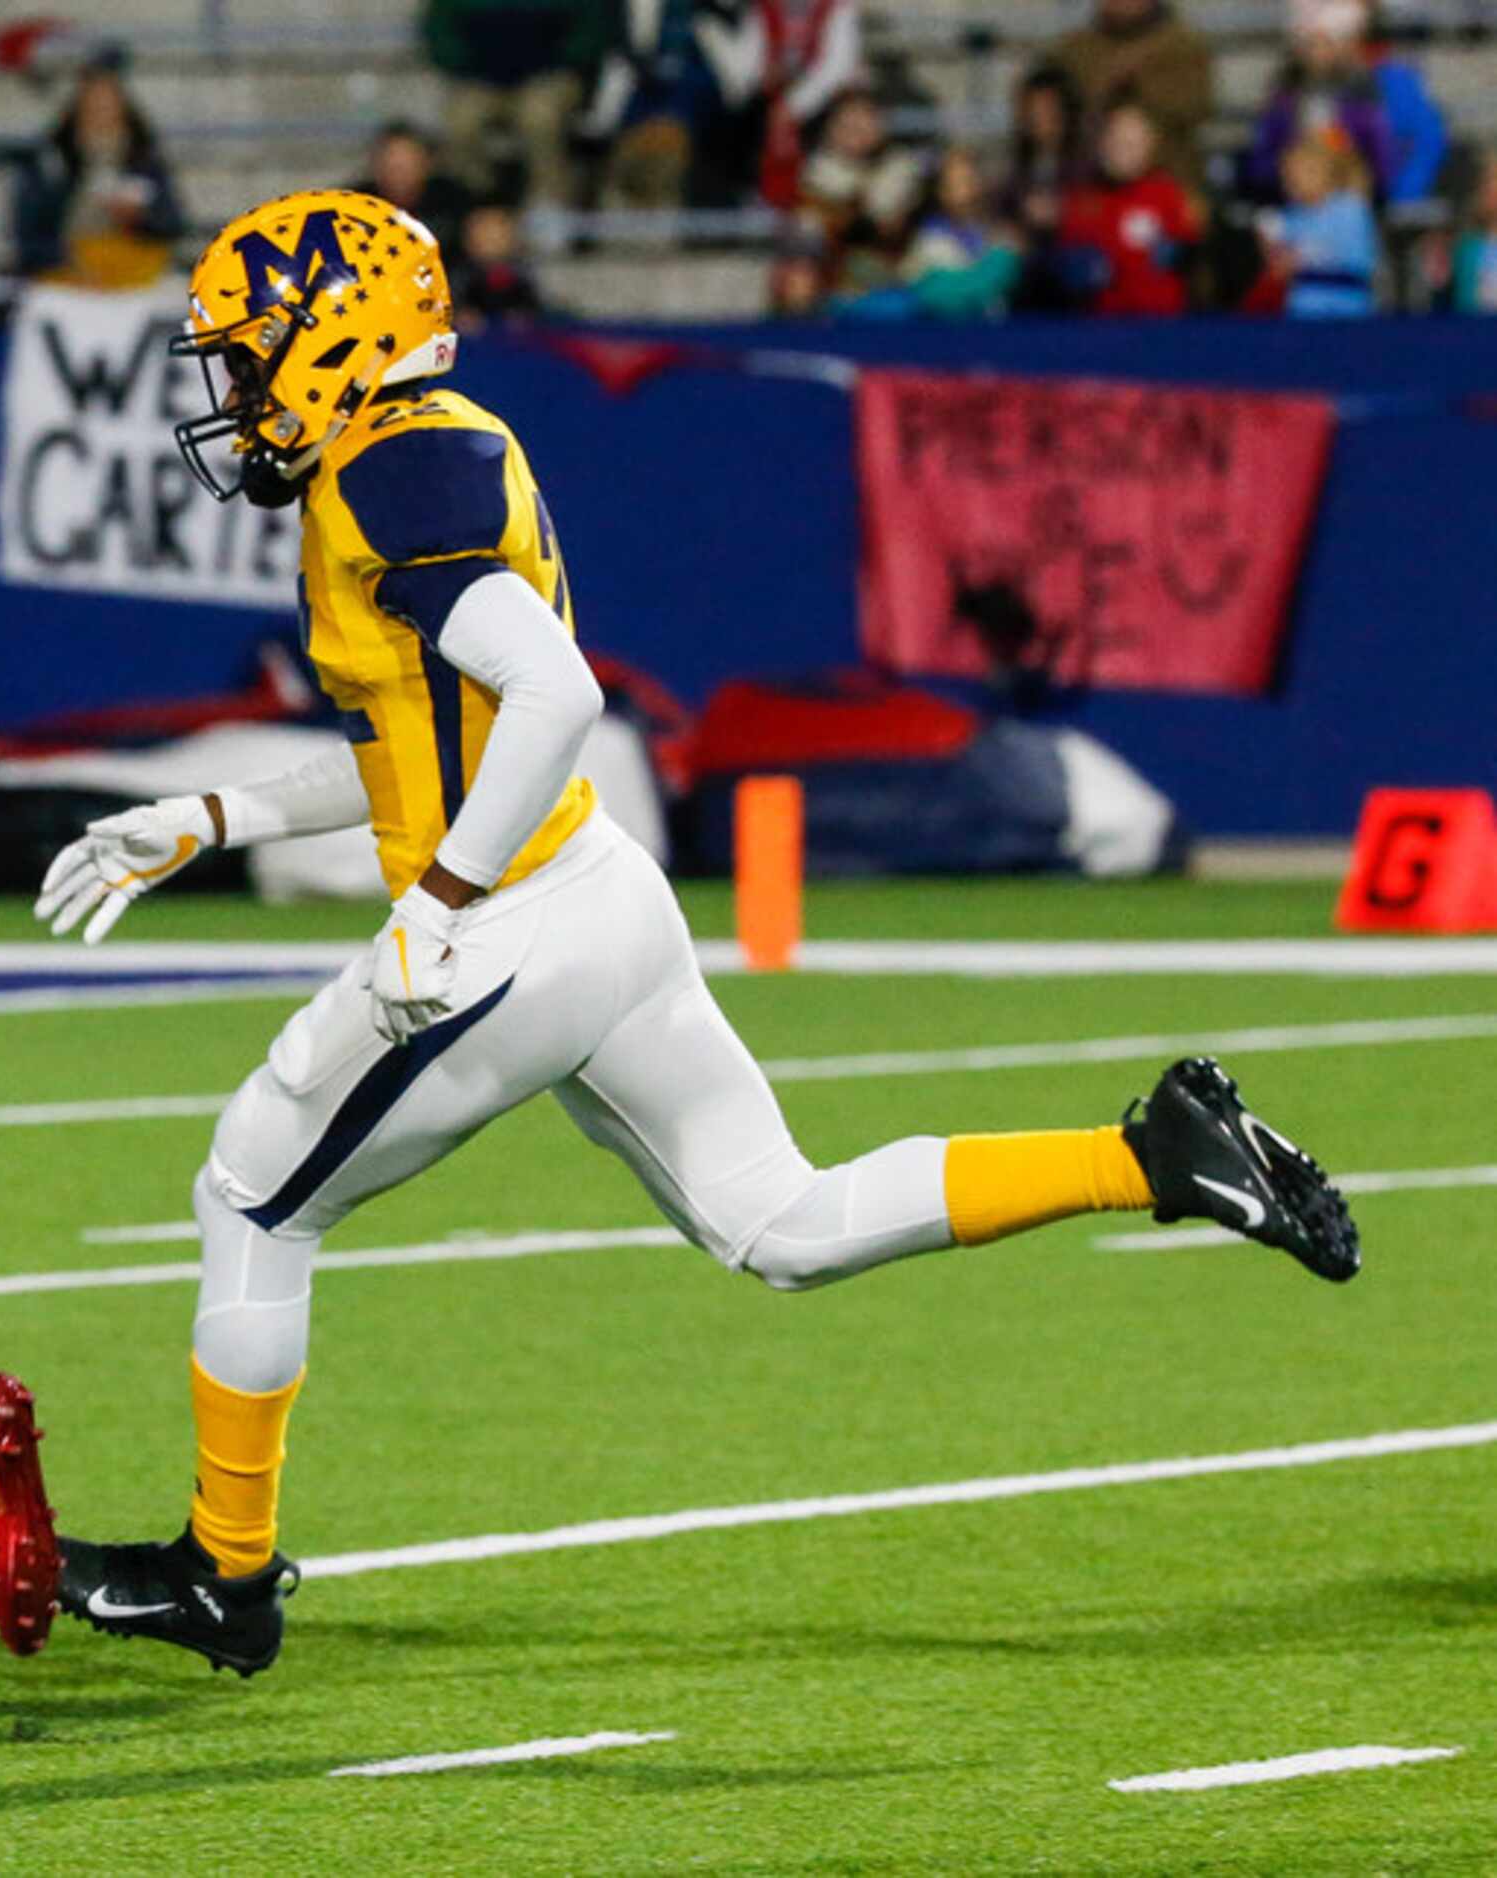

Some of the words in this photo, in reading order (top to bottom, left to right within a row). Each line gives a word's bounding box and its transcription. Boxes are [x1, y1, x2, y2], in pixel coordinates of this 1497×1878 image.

[233, 209, 359, 320] M
[40, 316, 194, 418] WE
[1366, 813, 1442, 910] G
